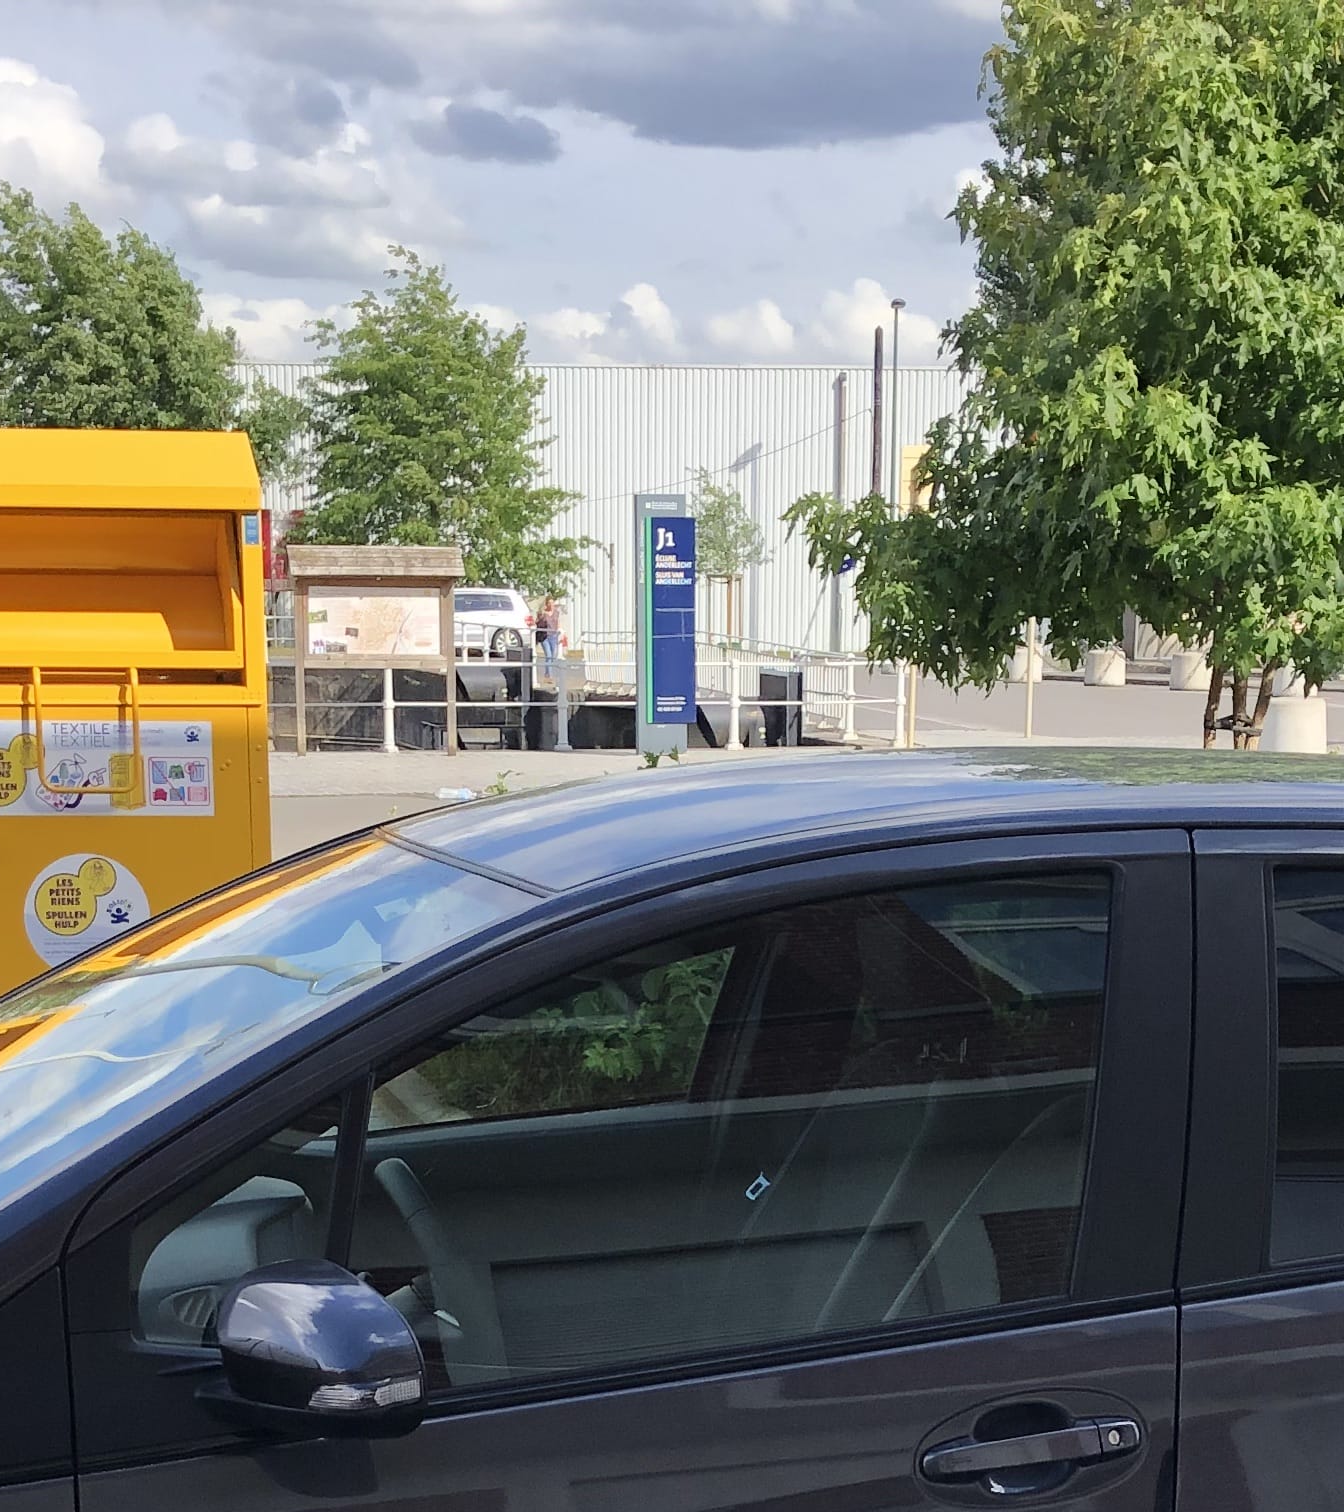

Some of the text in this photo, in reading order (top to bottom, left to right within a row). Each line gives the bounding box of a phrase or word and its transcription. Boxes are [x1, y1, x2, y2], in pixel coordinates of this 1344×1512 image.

[656, 527, 676, 551] J1
[655, 561, 693, 569] ANDERLECHT
[51, 723, 110, 735] TEXTILE
[52, 735, 111, 748] TEXTIEL
[56, 879, 74, 887] LES
[49, 888, 82, 897] PETITS
[51, 897, 81, 906] RIENS
[46, 911, 87, 920] SPULLEN
[54, 920, 80, 929] HULP
